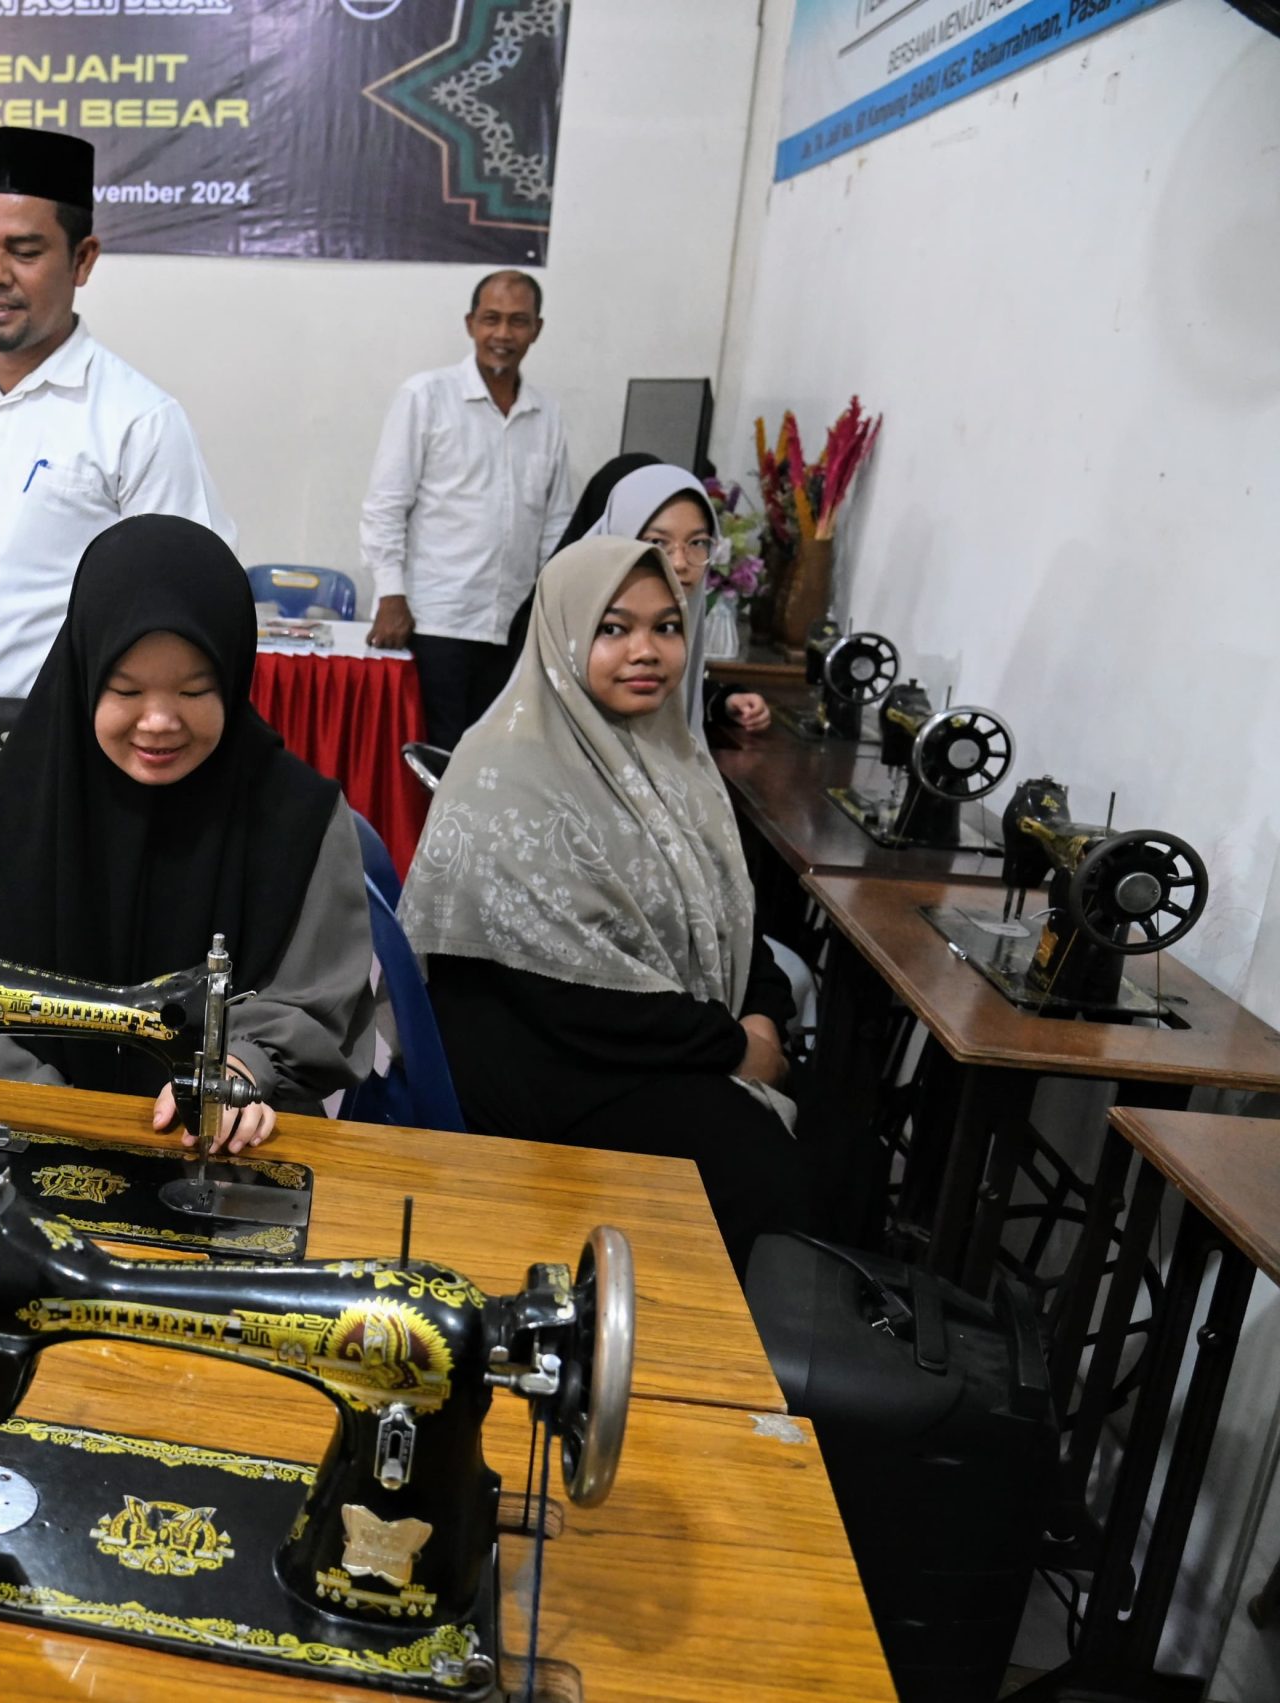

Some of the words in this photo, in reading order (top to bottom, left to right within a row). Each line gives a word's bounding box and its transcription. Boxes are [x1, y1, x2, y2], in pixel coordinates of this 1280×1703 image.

[79, 99, 250, 128] BESAR
[92, 180, 186, 204] vember
[191, 181, 251, 204] 2024
[40, 1000, 149, 1031] BUTTERFLY
[71, 1302, 229, 1342] BUTTERFLY
